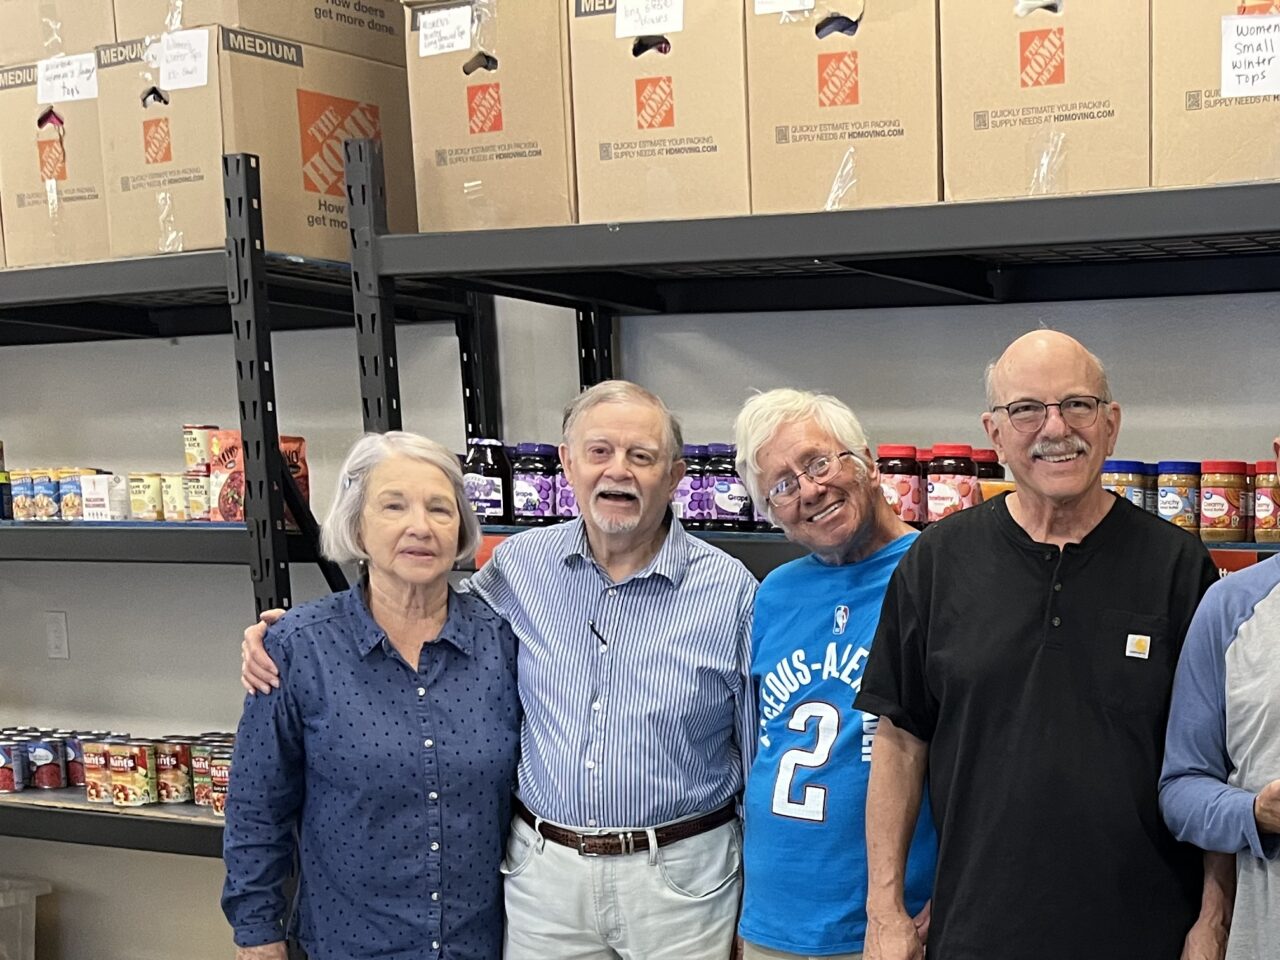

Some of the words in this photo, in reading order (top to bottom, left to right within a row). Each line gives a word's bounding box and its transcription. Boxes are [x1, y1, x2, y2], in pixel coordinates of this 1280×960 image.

[354, 1, 385, 18] doers
[581, 0, 616, 13] MED
[314, 7, 334, 19] get
[336, 12, 365, 28] more
[229, 32, 297, 62] MEDIUM
[1021, 27, 1064, 88] HOME
[0, 68, 38, 87] MEDIU
[819, 51, 858, 106] HOME
[991, 109, 1020, 119] QUICKLY
[1021, 105, 1055, 116] ESTIMATE
[1056, 102, 1078, 112] YOUR
[1078, 99, 1111, 110] PACKING
[1204, 98, 1234, 109] SUPPLY
[1234, 96, 1261, 106] NEEDS
[1261, 95, 1272, 104] AT
[307, 106, 341, 143] THE
[819, 122, 850, 132] ESTIMATE
[991, 119, 1018, 129] SUPPLY
[1019, 116, 1043, 126] NEEDS
[1043, 115, 1054, 124] AT
[1054, 109, 1115, 123] HDMOVING.COM
[791, 133, 816, 143] SUPPLY
[848, 128, 905, 139] HDMOVING.COM
[318, 199, 345, 214] How
[307, 215, 327, 227] get
[329, 217, 348, 230] mo
[772, 701, 839, 822] 2
